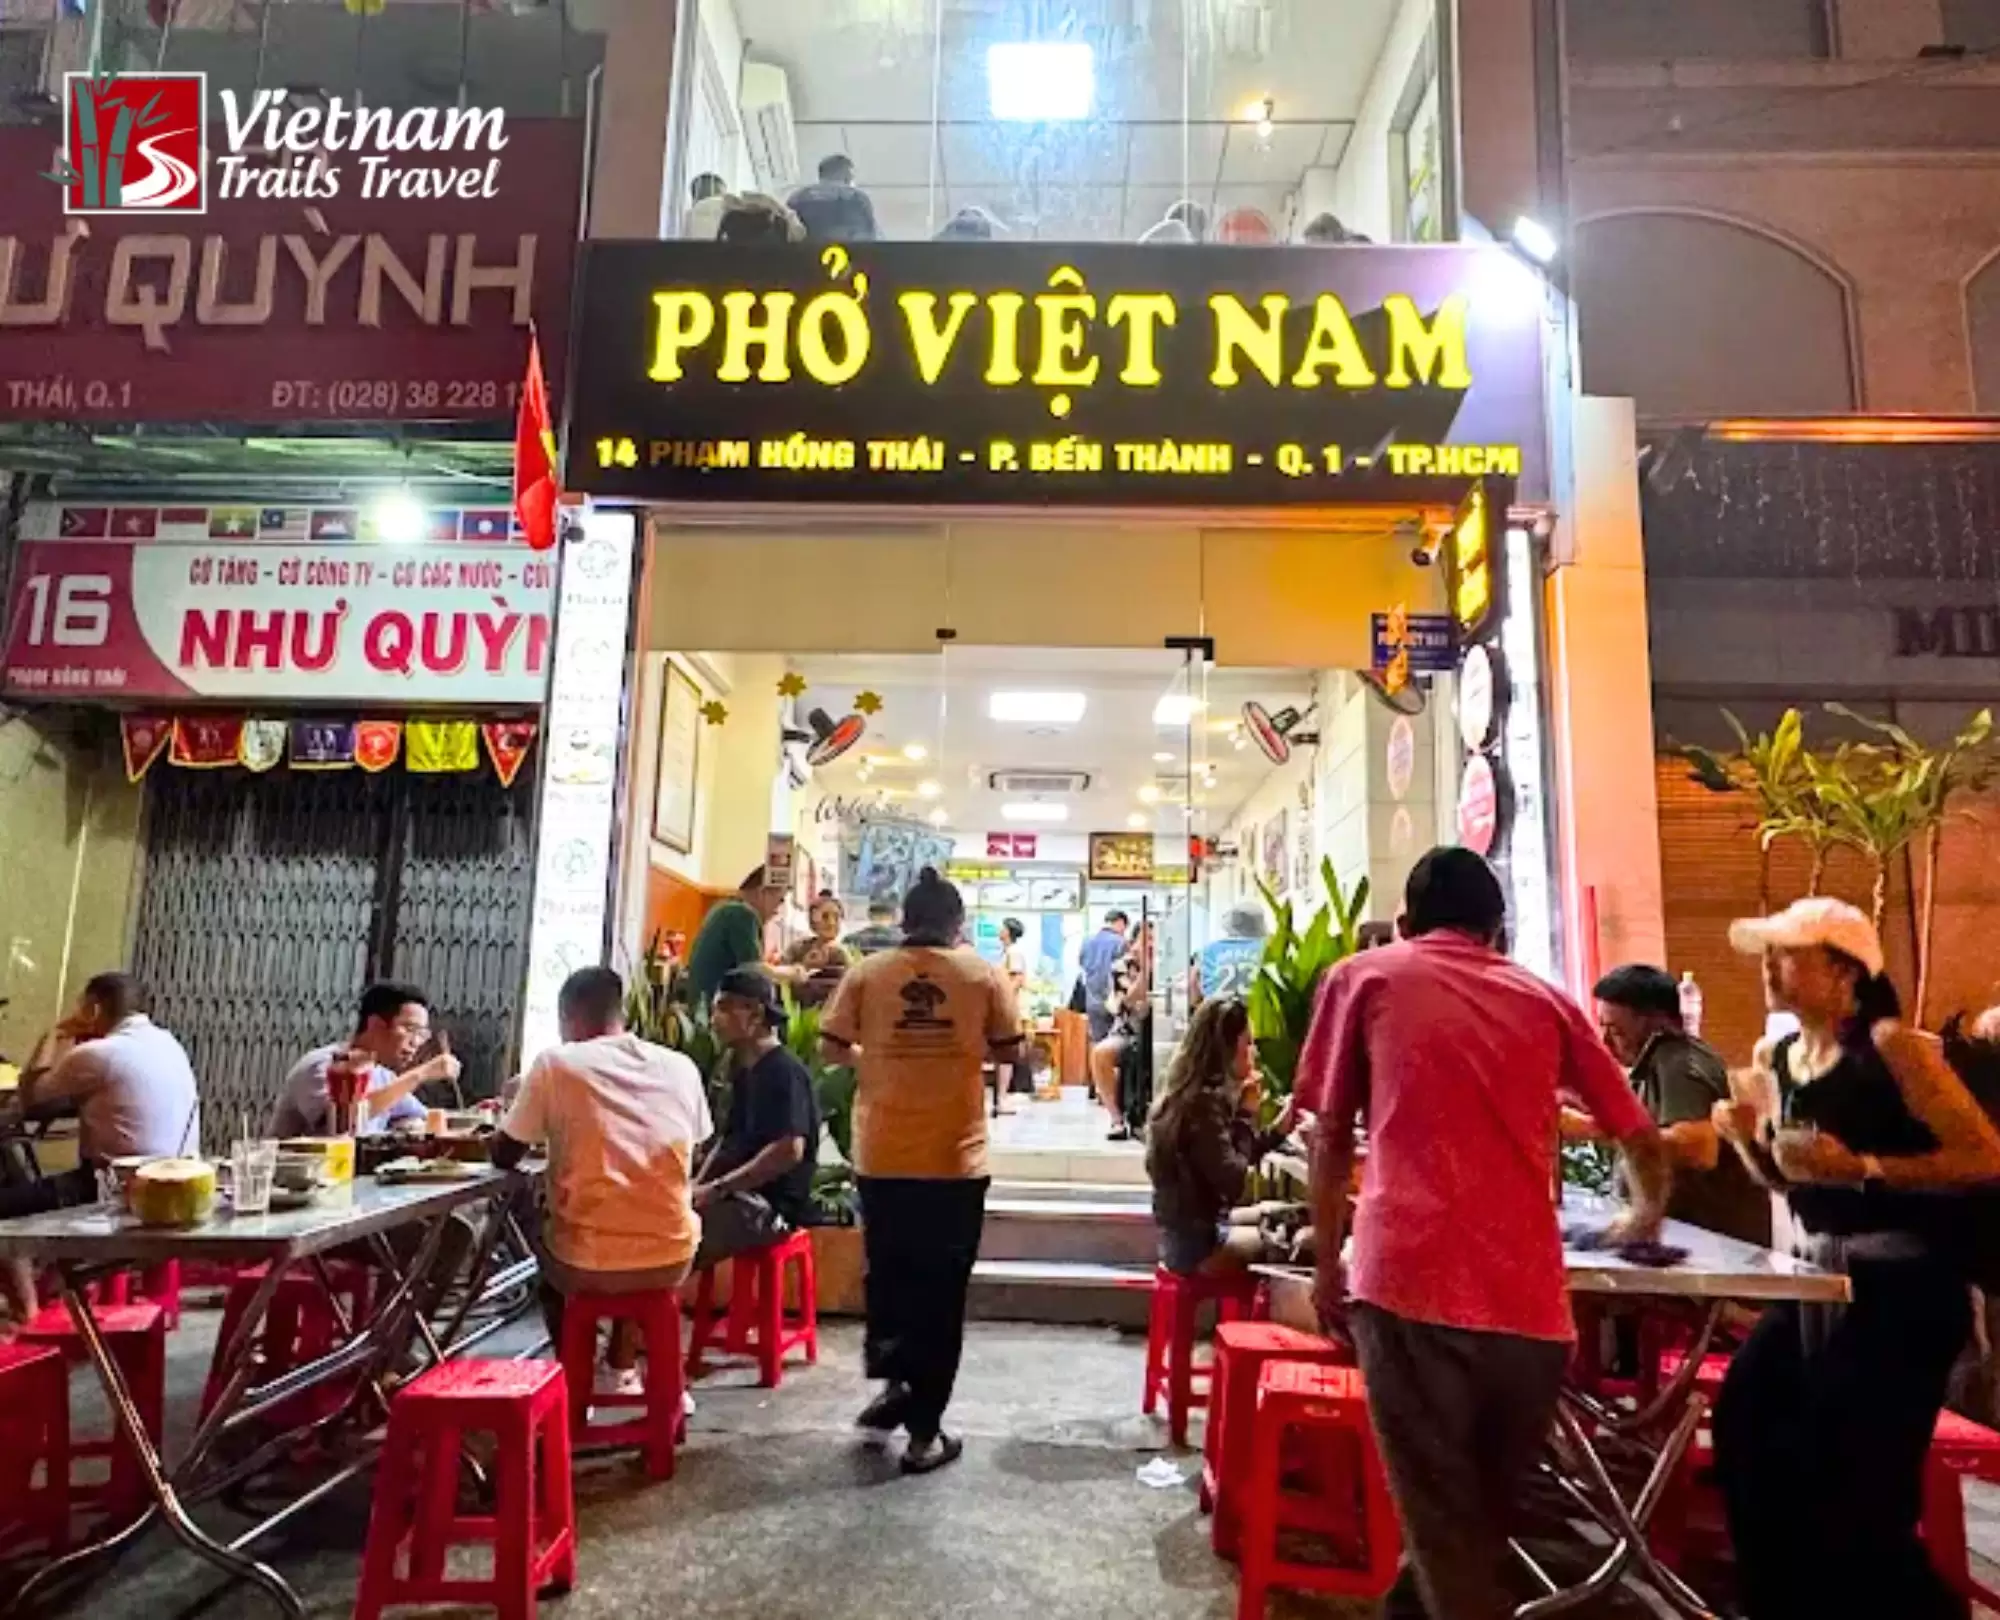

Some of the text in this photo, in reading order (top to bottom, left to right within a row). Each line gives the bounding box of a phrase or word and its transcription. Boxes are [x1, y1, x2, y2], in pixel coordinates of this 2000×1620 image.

[104, 207, 537, 354] QUỲNH
[647, 244, 1472, 417] PHỞ VIỆT NAM
[272, 380, 320, 408] ĐT:
[329, 380, 398, 415] (028)
[405, 381, 439, 408] 38
[445, 380, 497, 408] 228
[596, 437, 638, 468] 14
[650, 440, 749, 474] PHẠM
[867, 435, 944, 471] THÁI
[959, 452, 976, 463] -
[989, 442, 1019, 472] P.
[1030, 434, 1102, 472] BẾN
[1115, 438, 1232, 473] THÀNH
[1247, 454, 1263, 466] -
[1355, 455, 1372, 466] -
[1388, 444, 1520, 475] TP.HCM
[27, 573, 112, 645] 16
[355, 561, 374, 586] TY
[180, 597, 349, 672] NHƯ
